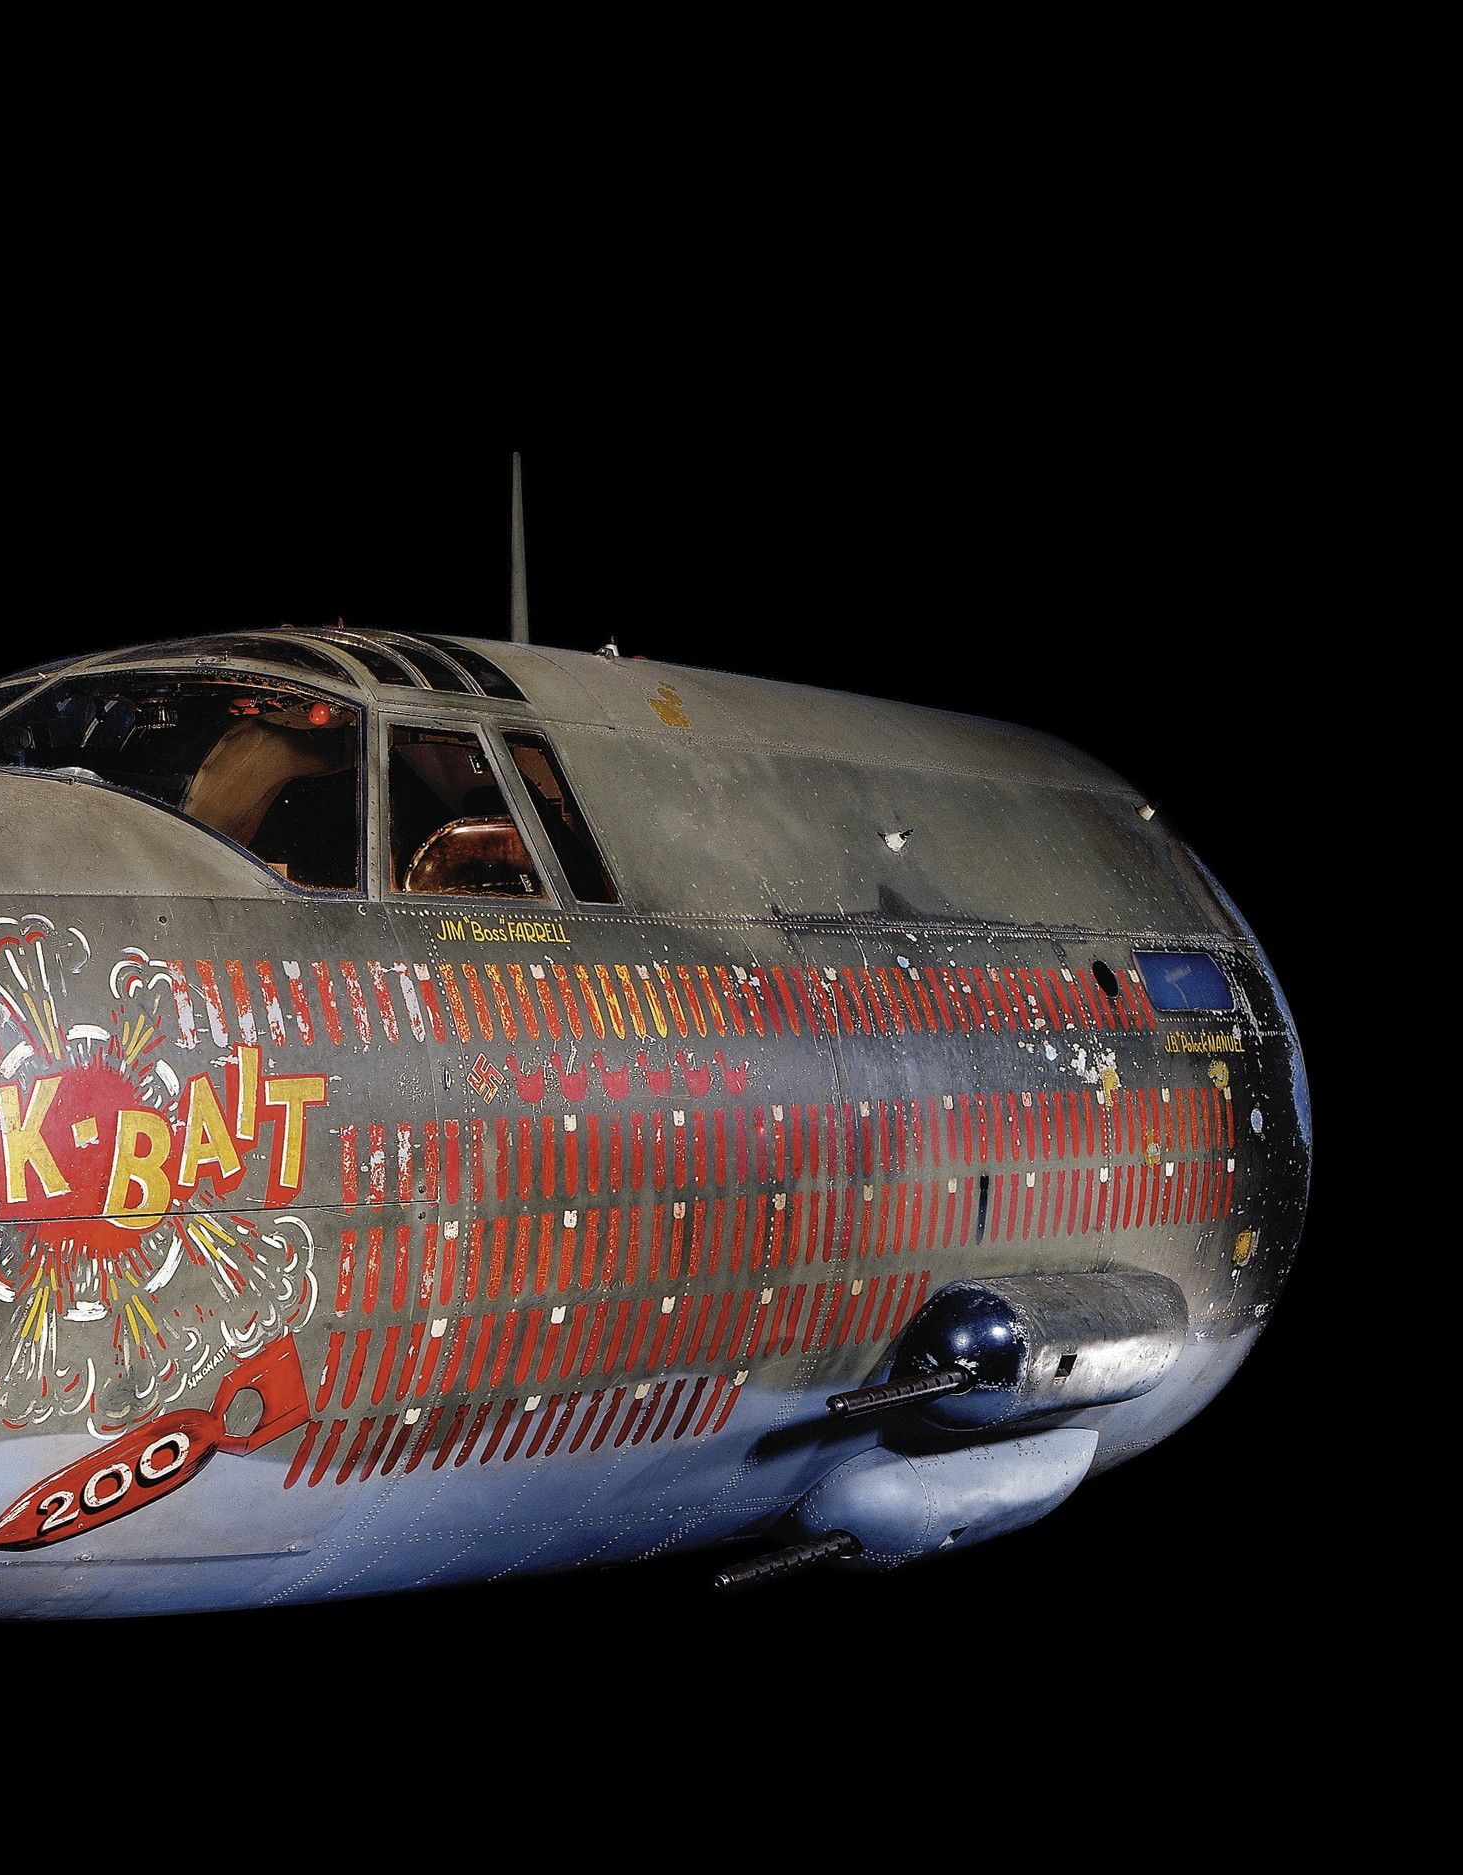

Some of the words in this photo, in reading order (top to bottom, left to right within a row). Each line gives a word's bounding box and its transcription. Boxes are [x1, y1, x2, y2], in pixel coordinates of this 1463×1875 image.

[436, 919, 466, 941] JIM
[463, 915, 507, 942] "Boss"
[507, 921, 571, 943] FARRELL
[1207, 1034, 1246, 1053] MANUEL
[37, 1431, 191, 1534] 200
